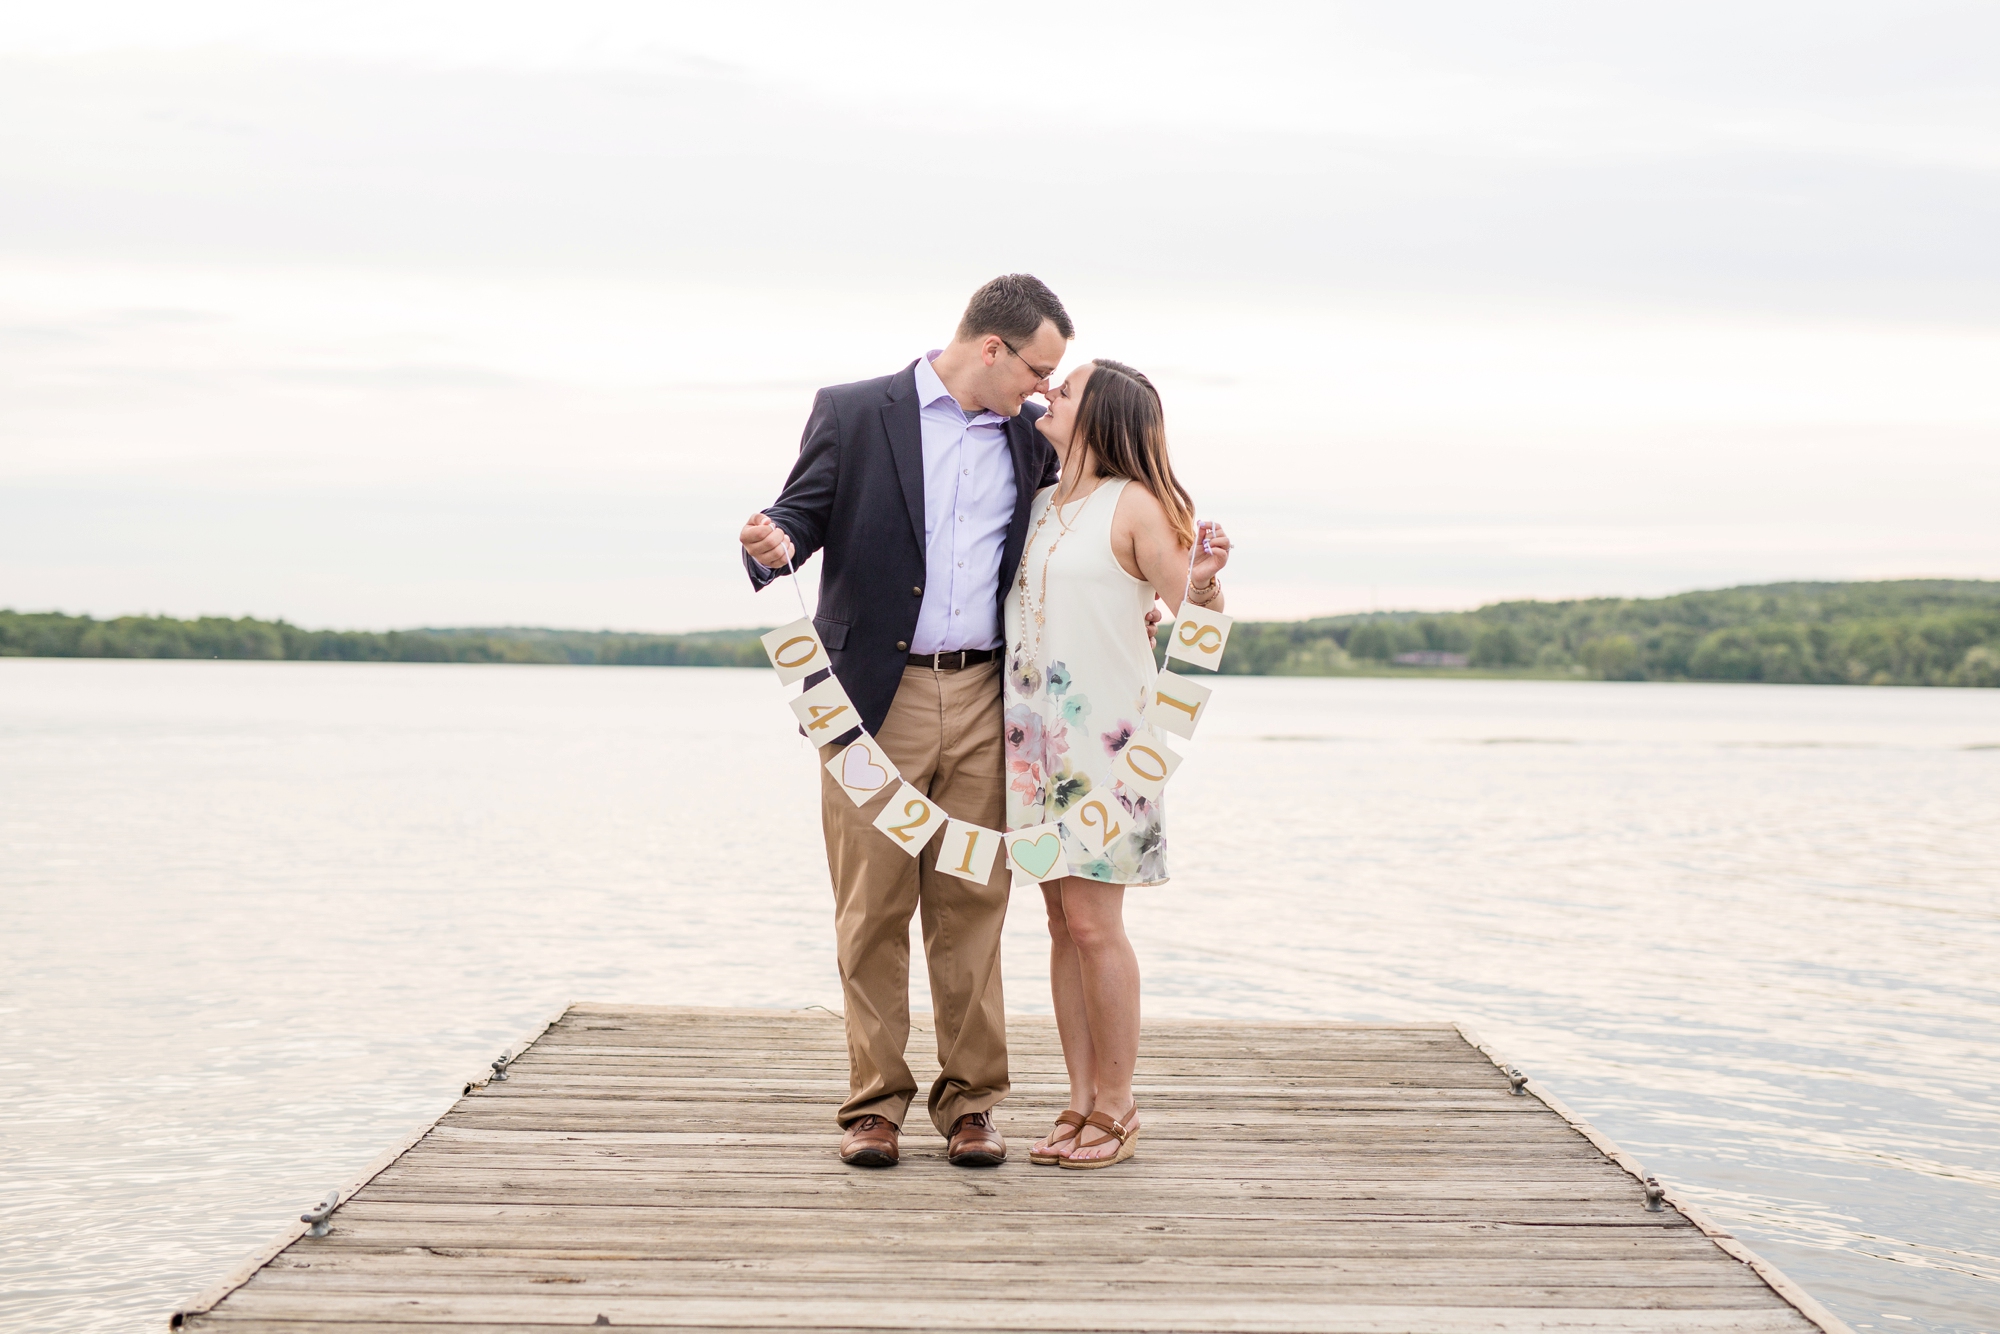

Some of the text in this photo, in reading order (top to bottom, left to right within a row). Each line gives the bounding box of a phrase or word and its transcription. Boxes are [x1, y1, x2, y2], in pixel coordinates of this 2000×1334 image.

[774, 636, 818, 668] 0
[1178, 619, 1222, 654] 8
[807, 704, 849, 731] 4
[1156, 689, 1202, 721] 1
[1125, 746, 1168, 782] 0
[887, 799, 931, 843] 2
[1080, 800, 1121, 847] 2
[953, 829, 980, 876] 1
